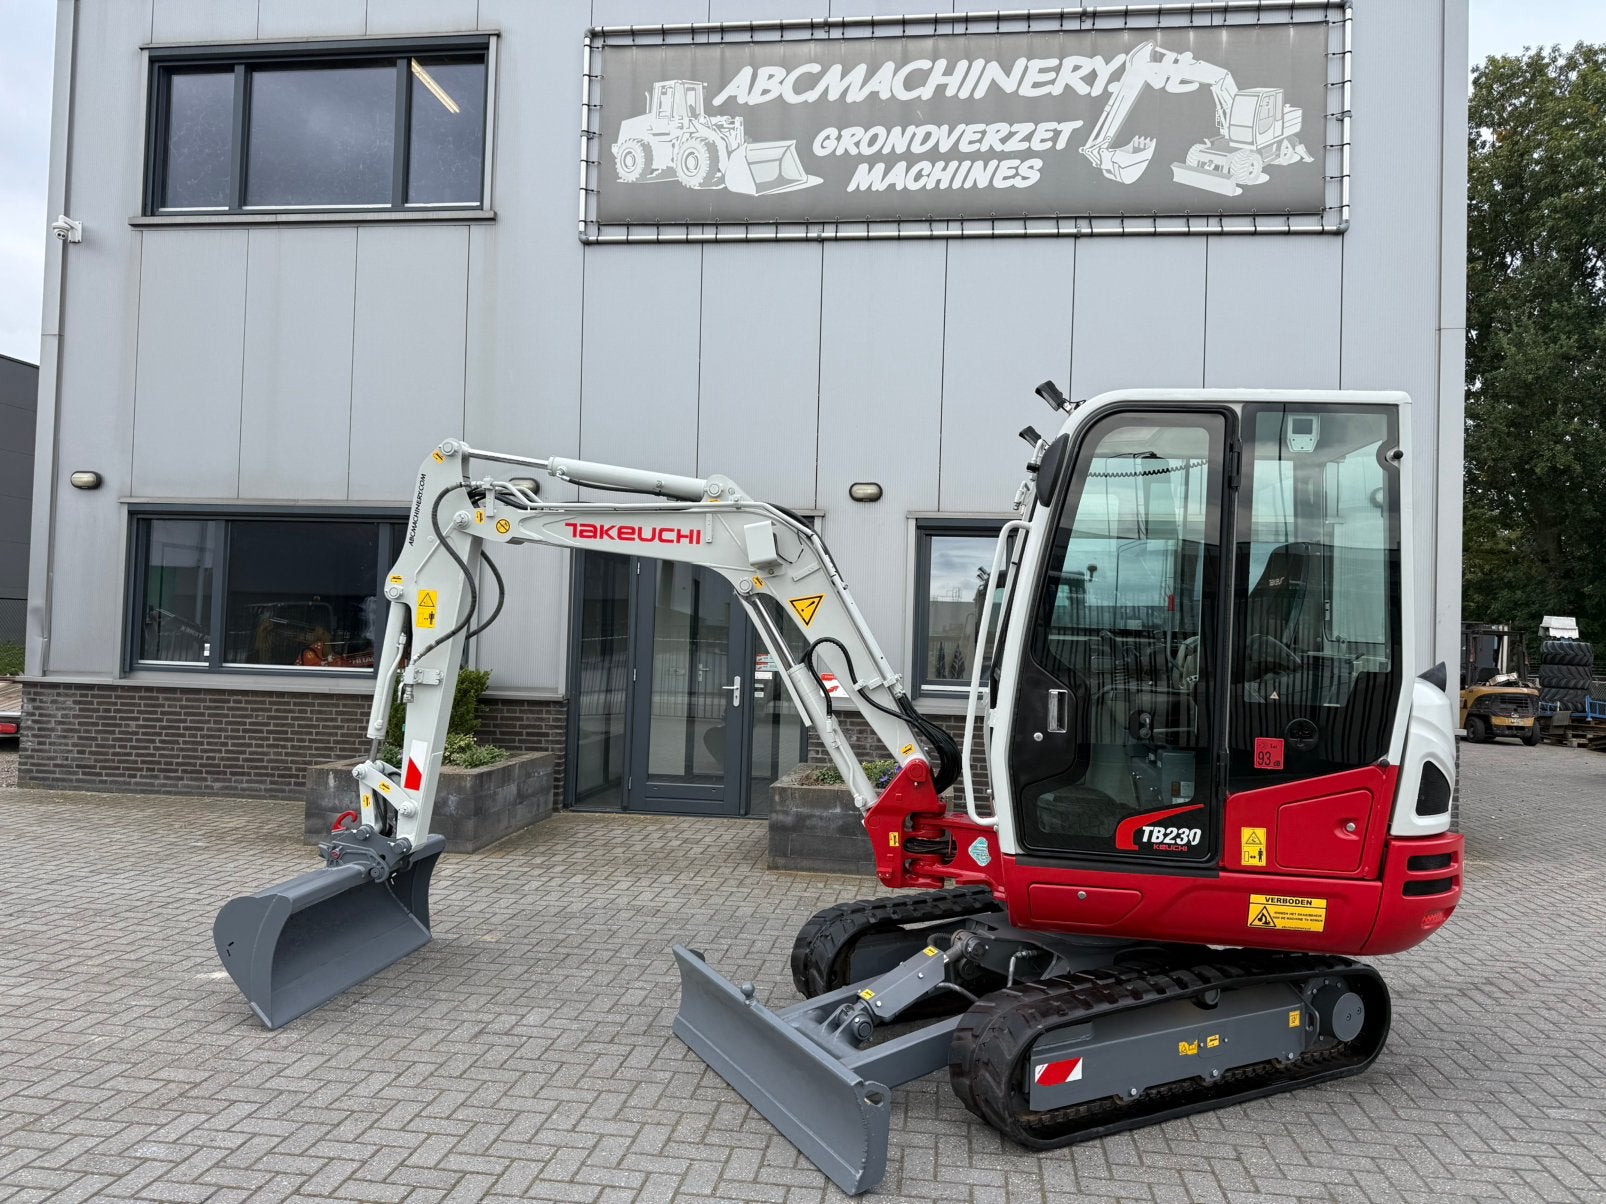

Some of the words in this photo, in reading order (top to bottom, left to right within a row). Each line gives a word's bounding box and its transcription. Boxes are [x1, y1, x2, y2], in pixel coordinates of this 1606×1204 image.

[812, 120, 1083, 156] GRONDVERZET
[846, 158, 1043, 192] MACHINES
[408, 473, 427, 547] ABCMACHINERY.COM
[565, 523, 702, 545] TAKEUCHI
[1257, 751, 1271, 766] 93
[1142, 826, 1202, 846] TB230
[1264, 896, 1313, 906] VERBODEN
